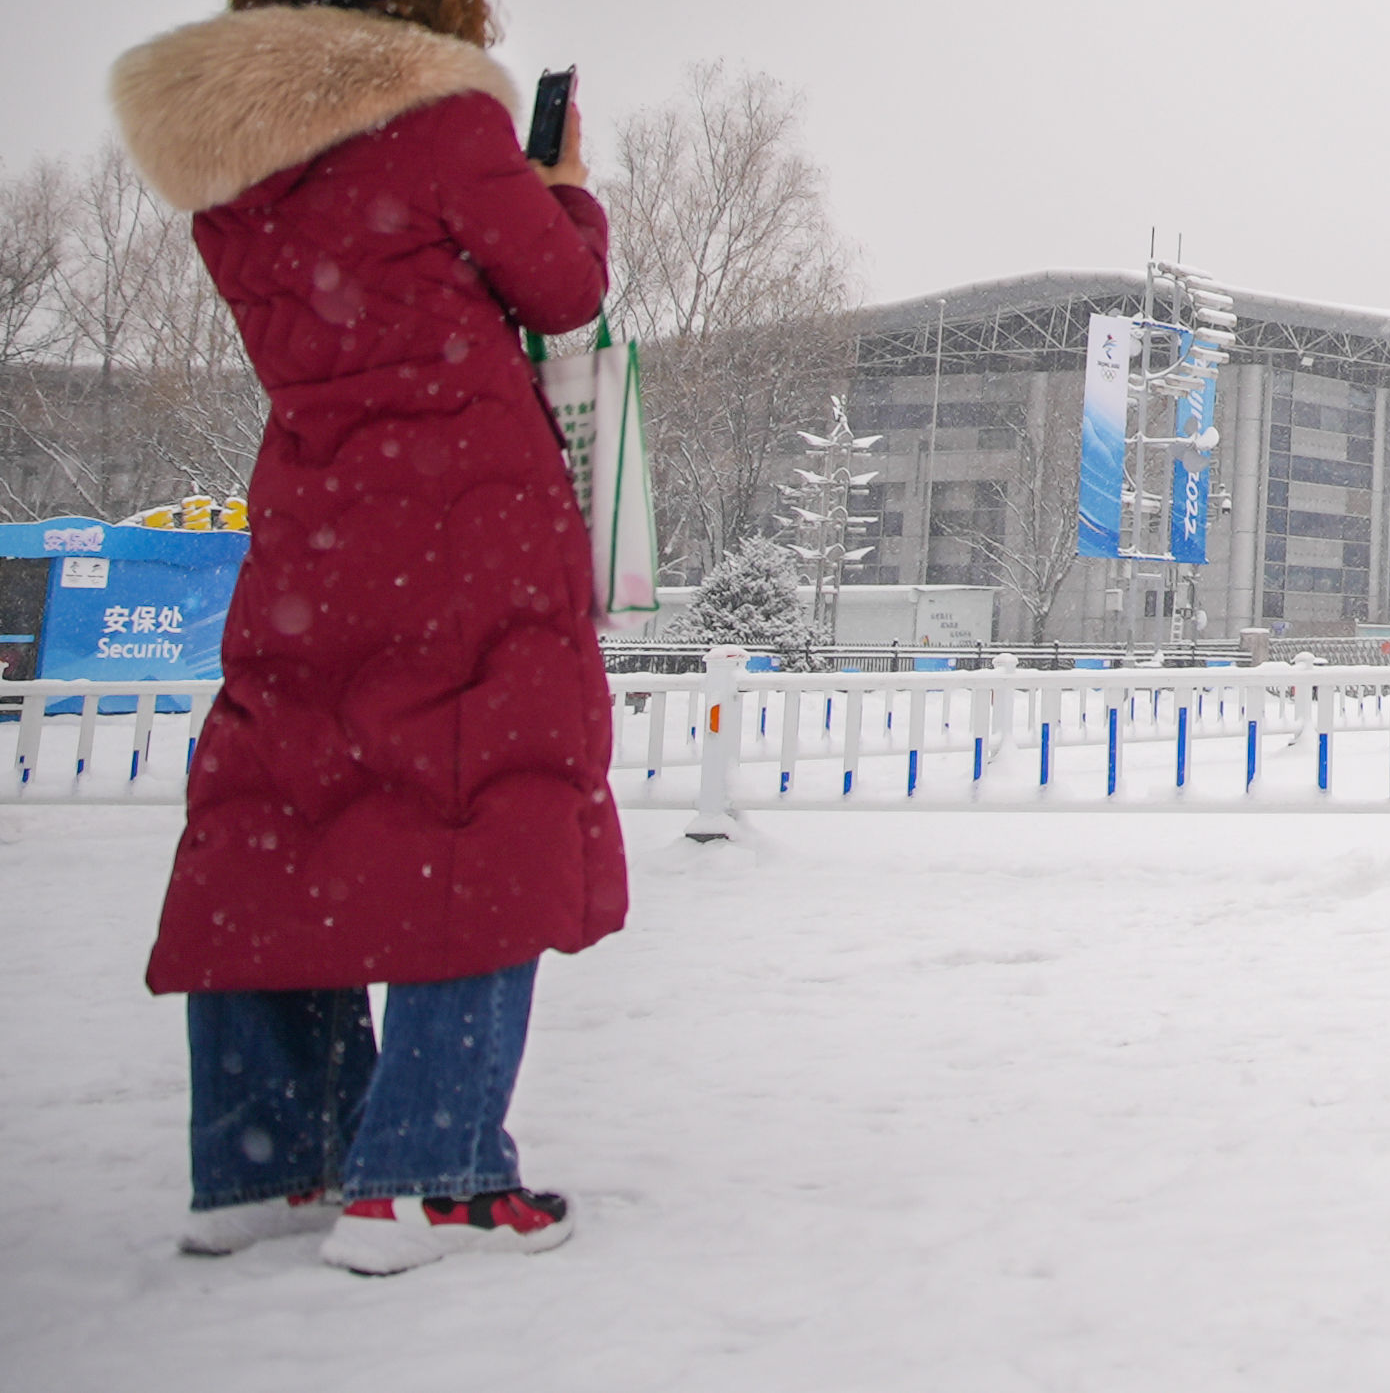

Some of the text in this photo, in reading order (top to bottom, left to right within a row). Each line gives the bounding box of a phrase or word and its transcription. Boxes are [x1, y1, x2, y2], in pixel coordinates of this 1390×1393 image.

[103, 606, 183, 634] 安保处
[97, 638, 183, 663] Security
